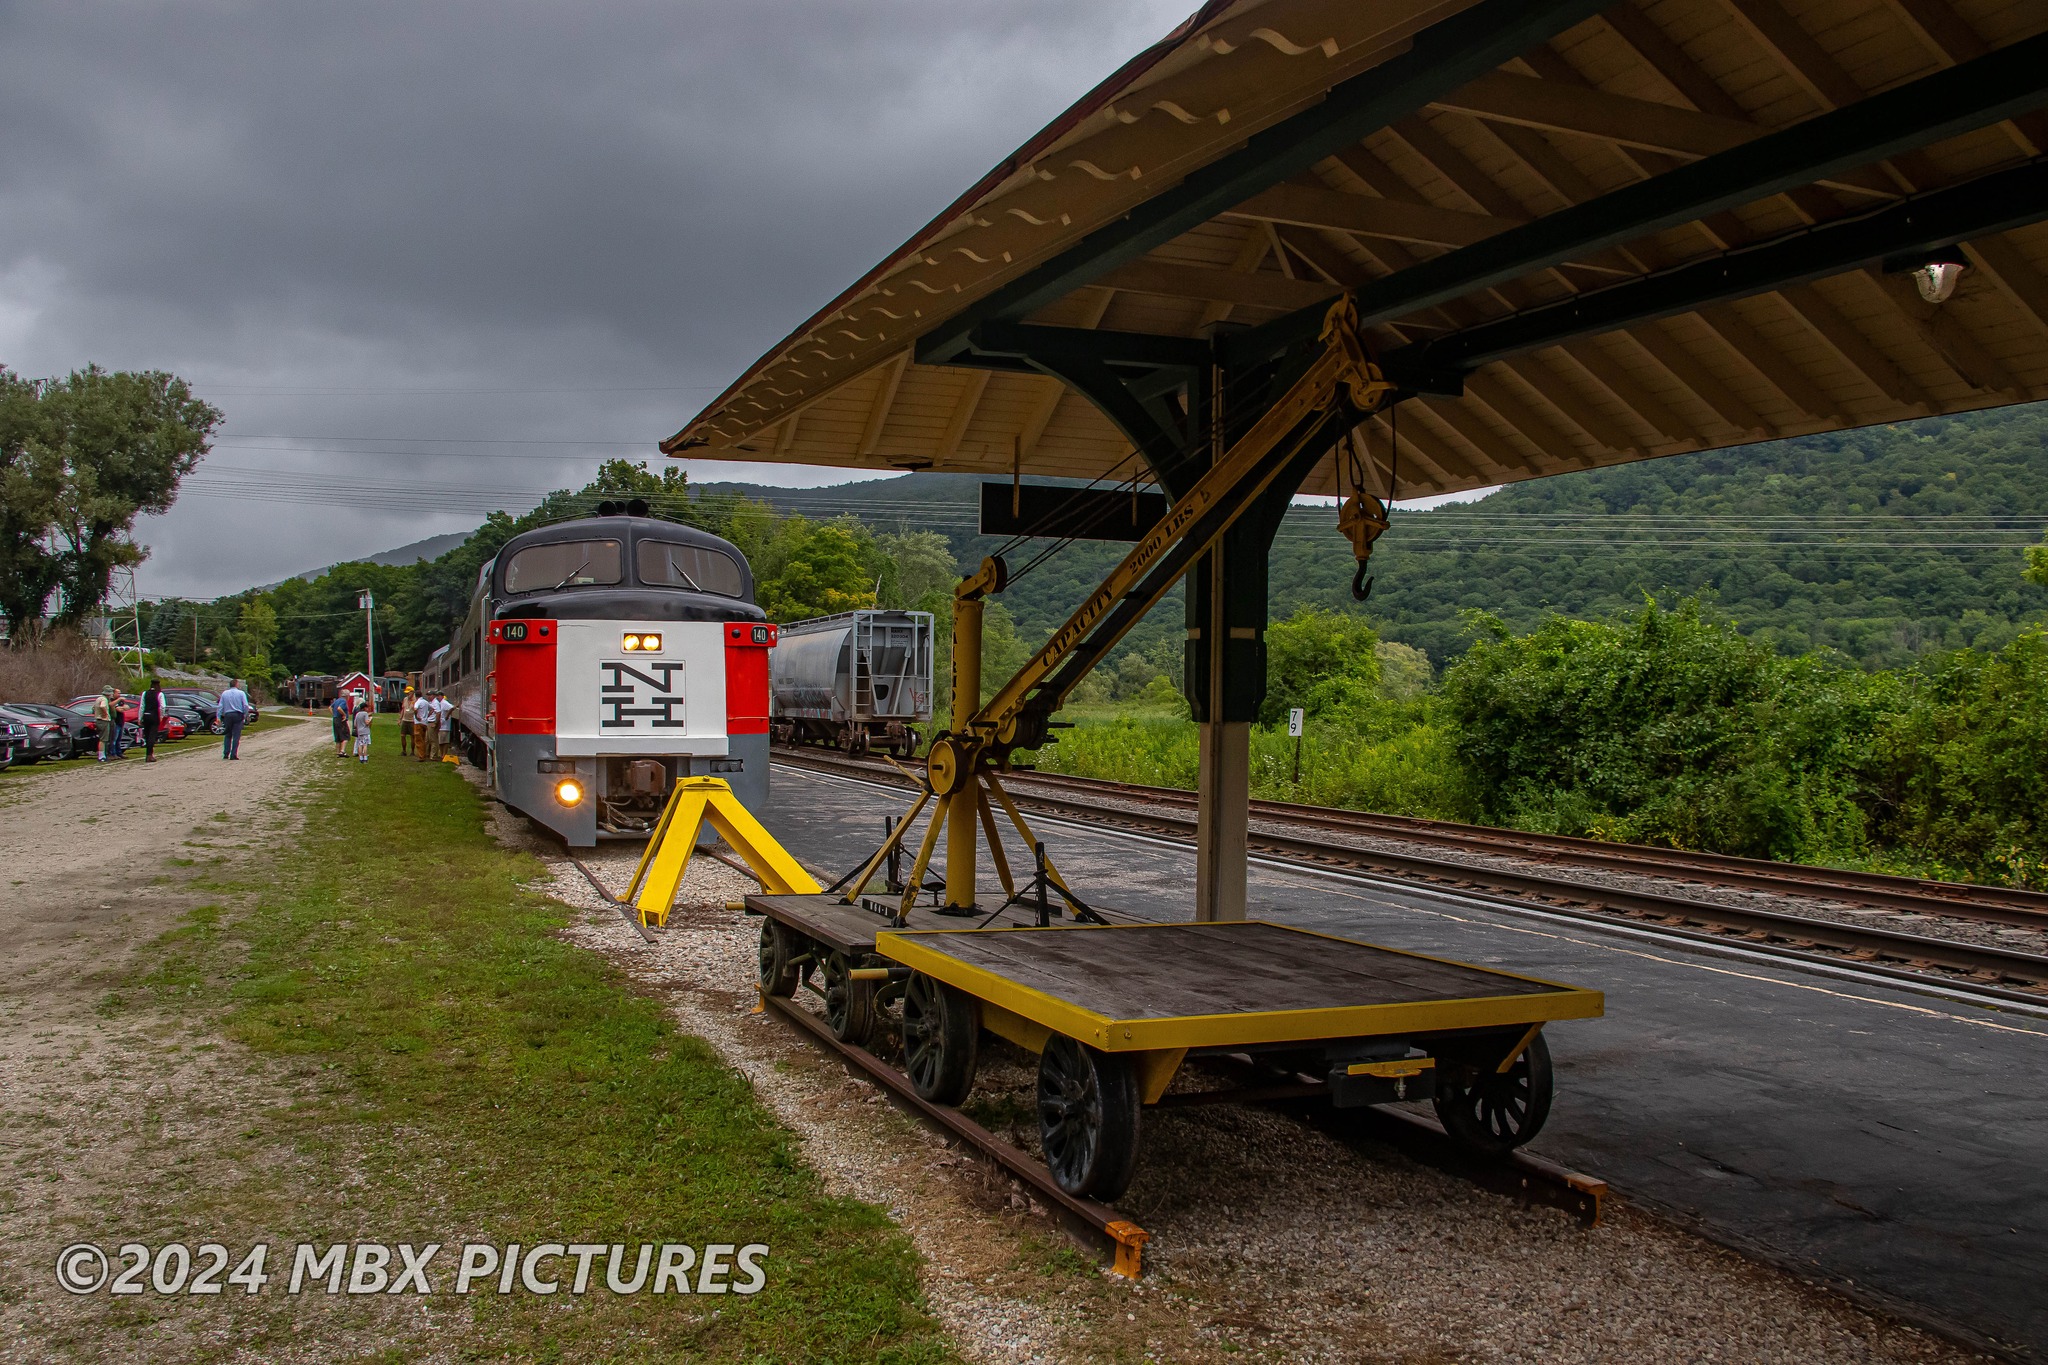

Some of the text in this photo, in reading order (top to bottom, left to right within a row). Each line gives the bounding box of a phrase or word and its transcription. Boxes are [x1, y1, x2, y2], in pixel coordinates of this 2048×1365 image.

[1042, 504, 1194, 667] CAPACITY 2000 LBS
[506, 625, 524, 638] 140
[753, 628, 766, 641] 140
